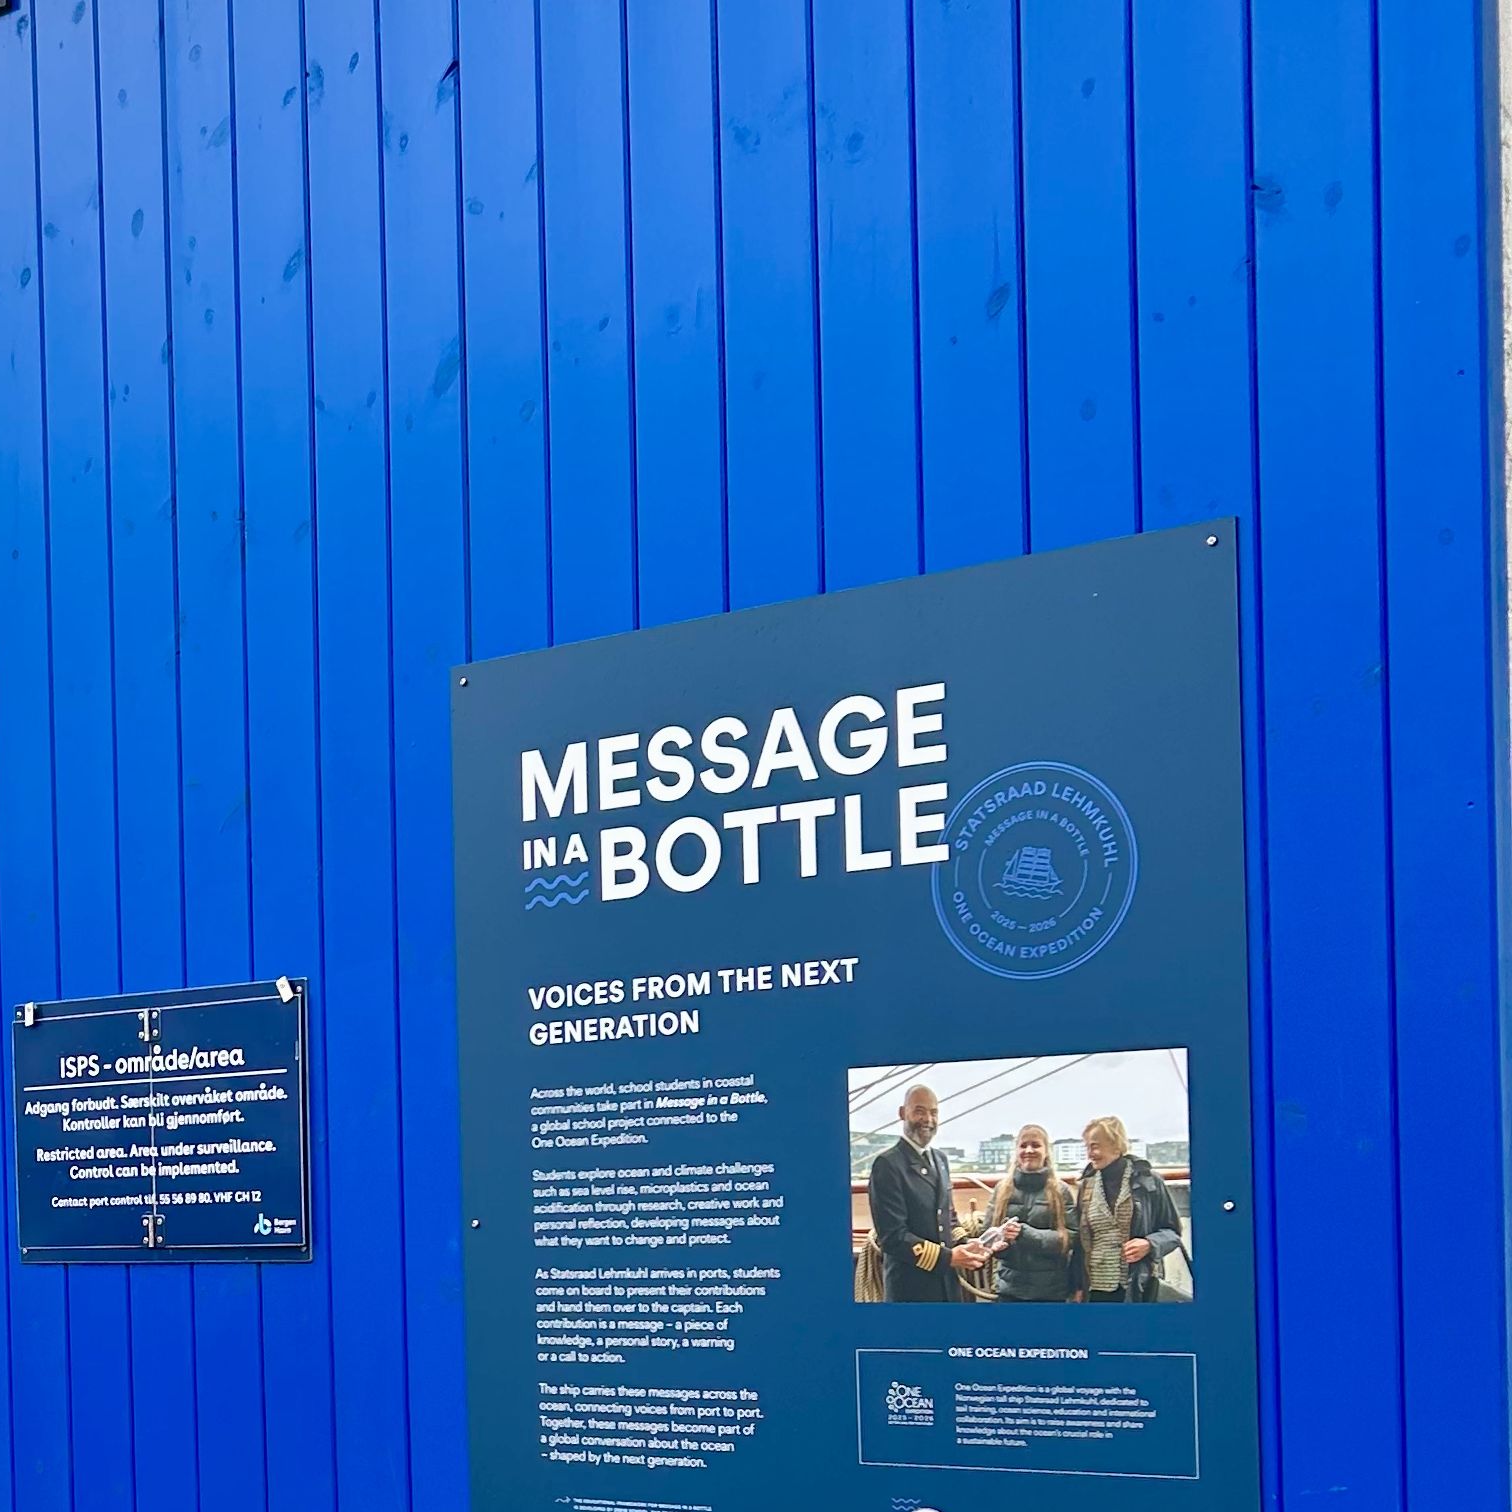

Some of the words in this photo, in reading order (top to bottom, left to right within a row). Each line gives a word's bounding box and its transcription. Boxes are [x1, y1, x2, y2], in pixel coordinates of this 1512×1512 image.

[520, 681, 949, 822] MESSAGE
[955, 781, 1047, 851] STATSRAAD
[1051, 782, 1119, 868] LEHMKUHL
[984, 809, 1033, 847] MESSAGE
[1036, 810, 1048, 820] IN
[1049, 813, 1059, 824] A
[1058, 816, 1090, 857] BOTTLE
[522, 837, 556, 870] IN
[562, 831, 588, 865] A
[599, 781, 950, 903] BOTTLE
[953, 891, 974, 924] ONE
[969, 923, 1016, 957] OCEAN
[1019, 906, 1104, 958] EXPEDITION
[990, 910, 1017, 930] 2025
[1028, 917, 1057, 933] 2026
[528, 980, 624, 1009] VOICES
[632, 972, 709, 1000] FROM
[718, 966, 772, 992] THE
[782, 958, 857, 987] NEXT
[529, 1010, 698, 1045] GENERATION
[60, 1055, 100, 1078] ISPS
[115, 1045, 245, 1074] område/area
[530, 1088, 564, 1098] Across
[566, 1085, 582, 1096] the
[584, 1083, 616, 1095] world,
[618, 1081, 652, 1093] school
[654, 1079, 700, 1091] students
[702, 1078, 712, 1088] in
[714, 1075, 753, 1087] coastal
[24, 1101, 69, 1118] Adgang
[72, 1096, 119, 1111] forbudt.
[121, 1093, 170, 1108] Særskilt
[172, 1087, 233, 1106] overvåket
[235, 1083, 288, 1101] område.
[531, 1102, 594, 1115] communities
[596, 1100, 618, 1111] take
[620, 1100, 641, 1113] part
[643, 1099, 653, 1108] in
[655, 1097, 704, 1109] Message
[706, 1096, 717, 1105] in
[730, 1093, 767, 1104] Bottle,
[63, 1116, 121, 1131] Kontroller
[123, 1115, 145, 1128] kan
[148, 1112, 164, 1126] bli
[166, 1109, 244, 1129] gjennomført.
[531, 1123, 538, 1132] a
[539, 1119, 570, 1134] global
[572, 1117, 605, 1130] school
[607, 1116, 644, 1130] project
[646, 1112, 703, 1126] connected
[706, 1113, 717, 1123] to
[720, 1111, 737, 1122] the
[36, 1146, 94, 1161] Restricted
[96, 1148, 128, 1158] area.
[130, 1144, 158, 1157] Area
[161, 1142, 195, 1156] under
[197, 1139, 276, 1154] surveillance.
[531, 1137, 553, 1148] One
[555, 1136, 588, 1147] Ocean
[590, 1133, 647, 1148] Expedition.
[70, 1165, 114, 1179] Control
[116, 1166, 138, 1176] can
[141, 1163, 156, 1176] be
[158, 1160, 239, 1179] implemented.
[52, 1197, 88, 1207] Contact
[90, 1196, 108, 1209] port
[110, 1194, 143, 1206] control
[214, 1192, 233, 1202] VHF
[235, 1192, 249, 1202] CH
[251, 1191, 262, 1202] 12
[948, 1347, 972, 1357] ONE
[975, 1348, 1015, 1357] OCEAN
[1018, 1348, 1087, 1358] EXPEDITION
[539, 1383, 557, 1394] The
[559, 1384, 580, 1397] ship
[582, 1385, 615, 1396] carries
[617, 1385, 645, 1397] these
[648, 1389, 700, 1401] messages
[702, 1390, 737, 1400] across
[739, 1388, 757, 1400] the
[894, 1396, 933, 1409] OCEAN
[897, 1385, 922, 1398] ONE
[539, 1402, 572, 1412] ocean,
[574, 1402, 631, 1416] connecting
[634, 1403, 667, 1414] voices
[669, 1404, 695, 1415] from
[697, 1407, 720, 1418] port
[723, 1407, 734, 1417] to
[736, 1408, 763, 1420] port.
[539, 1415, 586, 1430] Together,
[588, 1418, 615, 1429] these
[617, 1421, 668, 1434] messages
[671, 1420, 715, 1433] become
[718, 1425, 740, 1436] part
[742, 1423, 754, 1434] of
[540, 1435, 546, 1443] a
[548, 1433, 579, 1446] global
[581, 1436, 645, 1447] conversation
[647, 1437, 678, 1449] about
[680, 1438, 698, 1450] the
[700, 1442, 734, 1451] ocean
[549, 1449, 586, 1463] shaped
[588, 1451, 601, 1465] by
[603, 1452, 620, 1463] the
[622, 1455, 644, 1464] next
[647, 1456, 706, 1468] generation.
